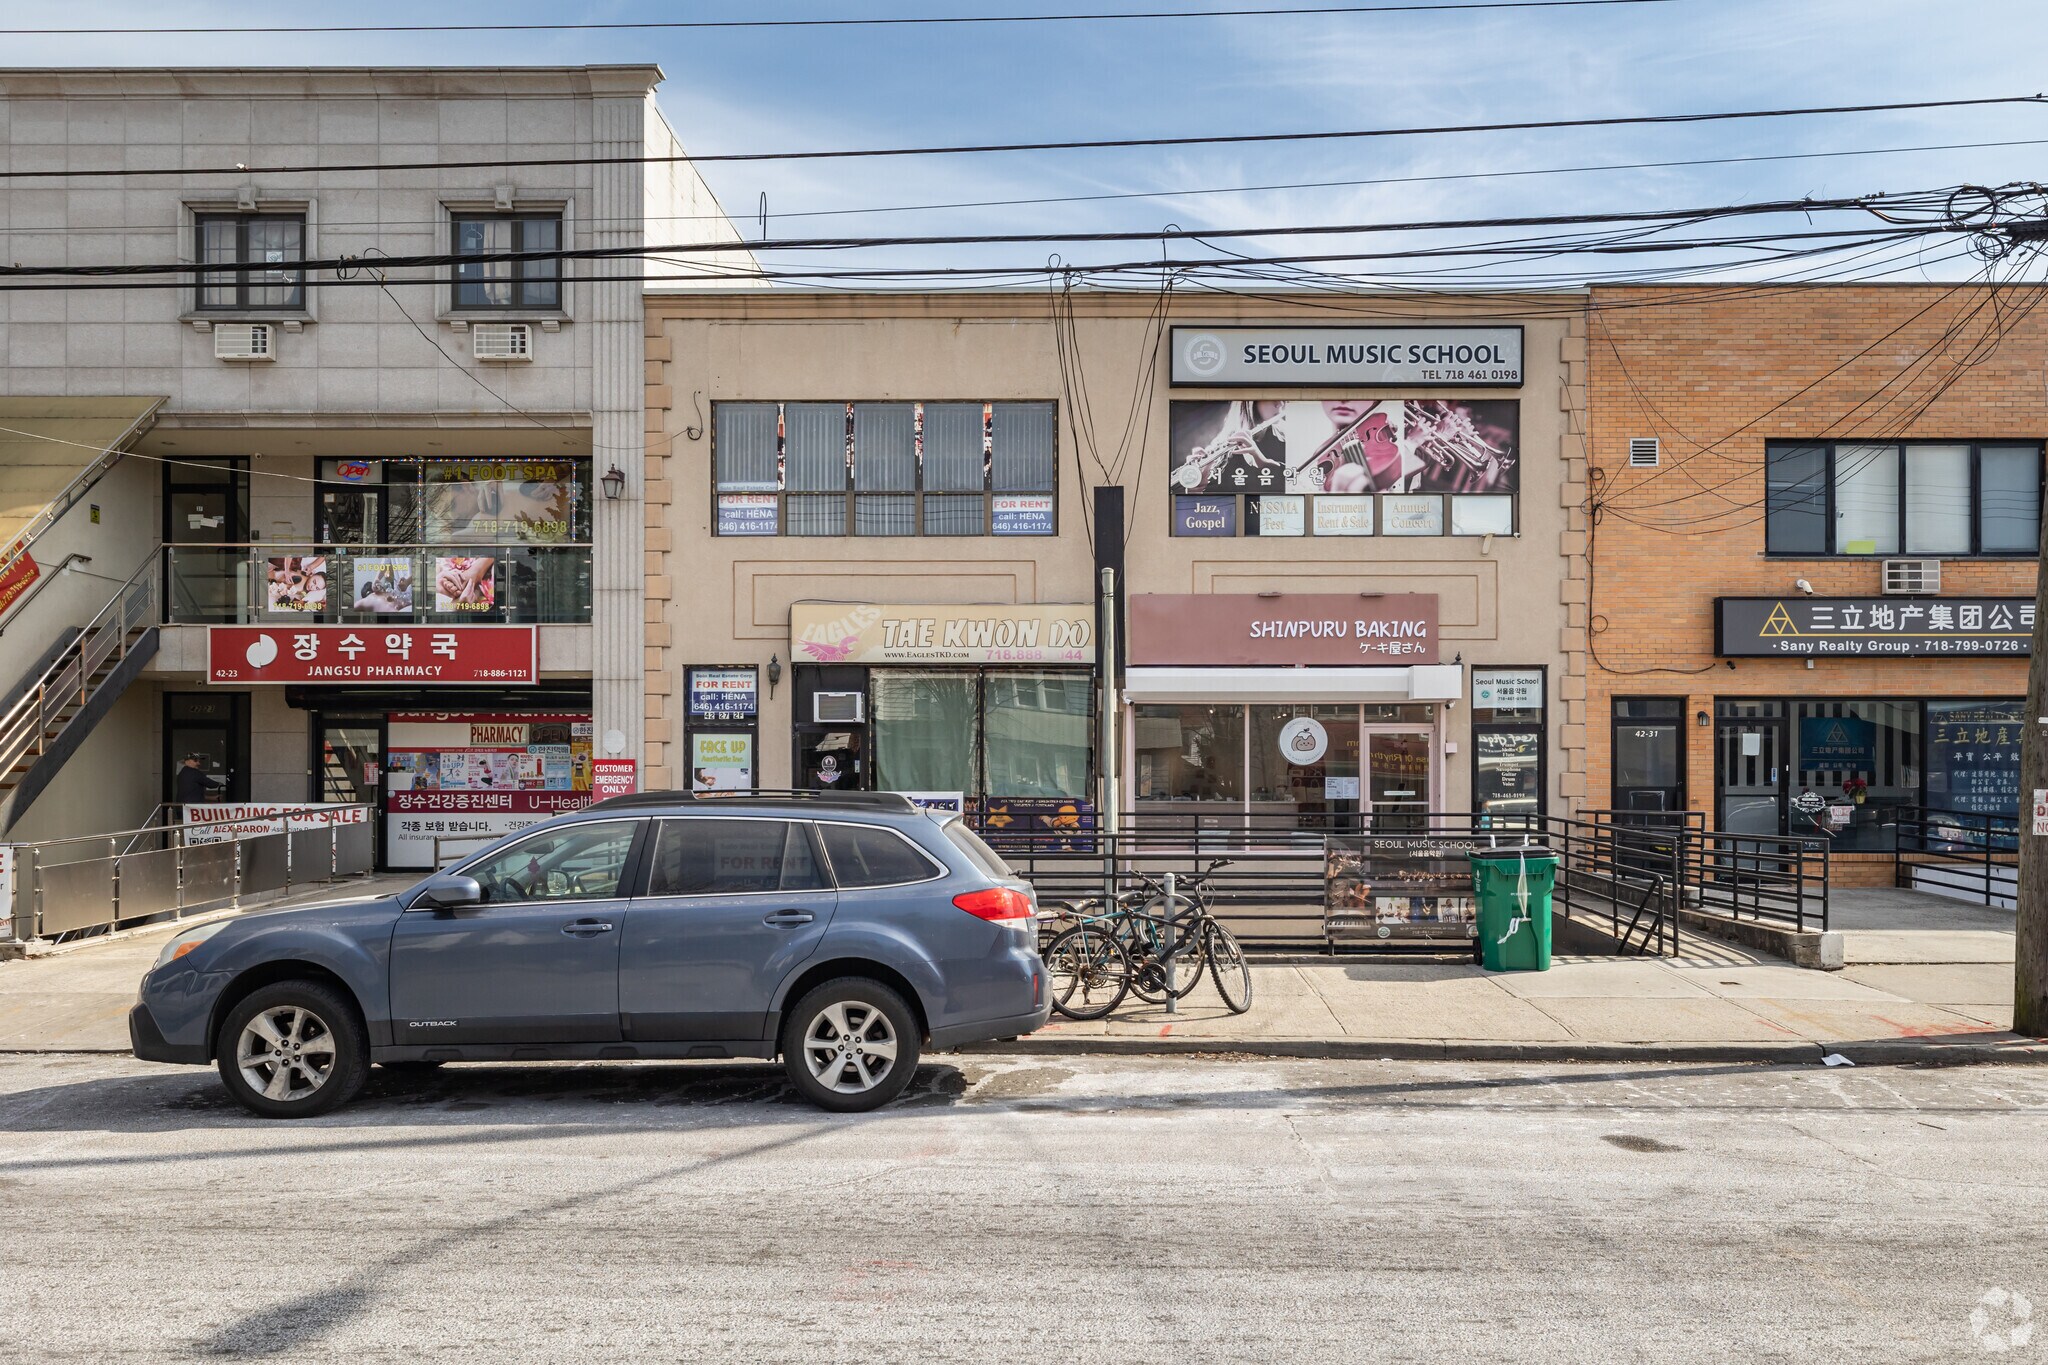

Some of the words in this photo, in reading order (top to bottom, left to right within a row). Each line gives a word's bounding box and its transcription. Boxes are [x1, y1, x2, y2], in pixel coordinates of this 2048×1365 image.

[1243, 344, 1321, 365] SEOUL
[1326, 344, 1402, 365] MUSIC
[1408, 344, 1506, 365] SCHOOL
[1421, 370, 1442, 380] TEL
[1444, 370, 1465, 380] 718
[1467, 370, 1488, 380] 461
[1490, 370, 1518, 380] 0198
[337, 464, 371, 478] Open
[444, 465, 463, 480] #1
[469, 465, 518, 481] FOOT
[523, 465, 558, 480] SPA
[1207, 467, 1326, 486] 서울음악원
[720, 495, 743, 504] FOR
[994, 500, 1017, 508] FOR
[1020, 500, 1050, 508] RENT
[724, 509, 744, 519] call:
[1194, 502, 1220, 514] Jazz,
[1250, 502, 1298, 515] NYSSMA
[1317, 502, 1367, 514] Instrument
[1393, 502, 1431, 514] Annual
[998, 512, 1017, 520] call:
[474, 520, 567, 534] 718-719-6898
[1013, 522, 1052, 530] 416-1174
[1186, 517, 1225, 530] Gospel
[1264, 517, 1285, 530] Test
[1317, 517, 1339, 529] Rent
[1341, 517, 1348, 528] &
[1350, 517, 1368, 528] Sale
[1391, 517, 1434, 529] Concert
[369, 564, 391, 572] FOOT
[801, 605, 881, 644] EAGLES
[1250, 621, 1348, 638] SHINPURU
[1355, 620, 1427, 638] BAKING
[882, 618, 936, 648] TAE
[943, 618, 1041, 648] KWON
[1048, 618, 1091, 648] DO
[1359, 641, 1426, 655] ケーキ屋さん
[1780, 640, 1815, 653] Sany
[1819, 640, 1863, 653] Realty
[1867, 640, 1910, 654] Group
[1924, 640, 2018, 652] 718-799-0726
[215, 669, 238, 678] 42-23
[307, 666, 361, 676] JANGSU
[367, 666, 442, 676] PHARMACY
[473, 669, 527, 678] 718-886-1121
[696, 681, 718, 689] FOR
[722, 681, 752, 689] RENT
[700, 693, 718, 701] call:
[714, 703, 754, 711] 416-1174
[471, 726, 523, 743] PHARMACY
[1635, 730, 1658, 738] 42-31
[700, 740, 727, 753] FACE
[731, 740, 746, 753] UP
[1982, 752, 2002, 761] 公平
[595, 775, 634, 784] EMERGENCY
[602, 785, 627, 793] ONLY
[398, 794, 512, 809] 장수건강증진센터
[190, 807, 277, 823] BUILDING
[283, 808, 314, 822] FOR
[319, 809, 362, 823] SALE
[236, 825, 270, 834] BARON
[401, 821, 420, 832] 각종
[425, 821, 445, 832] 보험
[448, 821, 492, 832] 받습니다.
[398, 833, 408, 841] All
[1374, 840, 1404, 849] SEOUL
[1407, 840, 1437, 849] MUSIC
[1438, 841, 1477, 849] SCHOOL
[720, 856, 755, 870] FOR
[409, 1020, 458, 1028] OUTBACK
